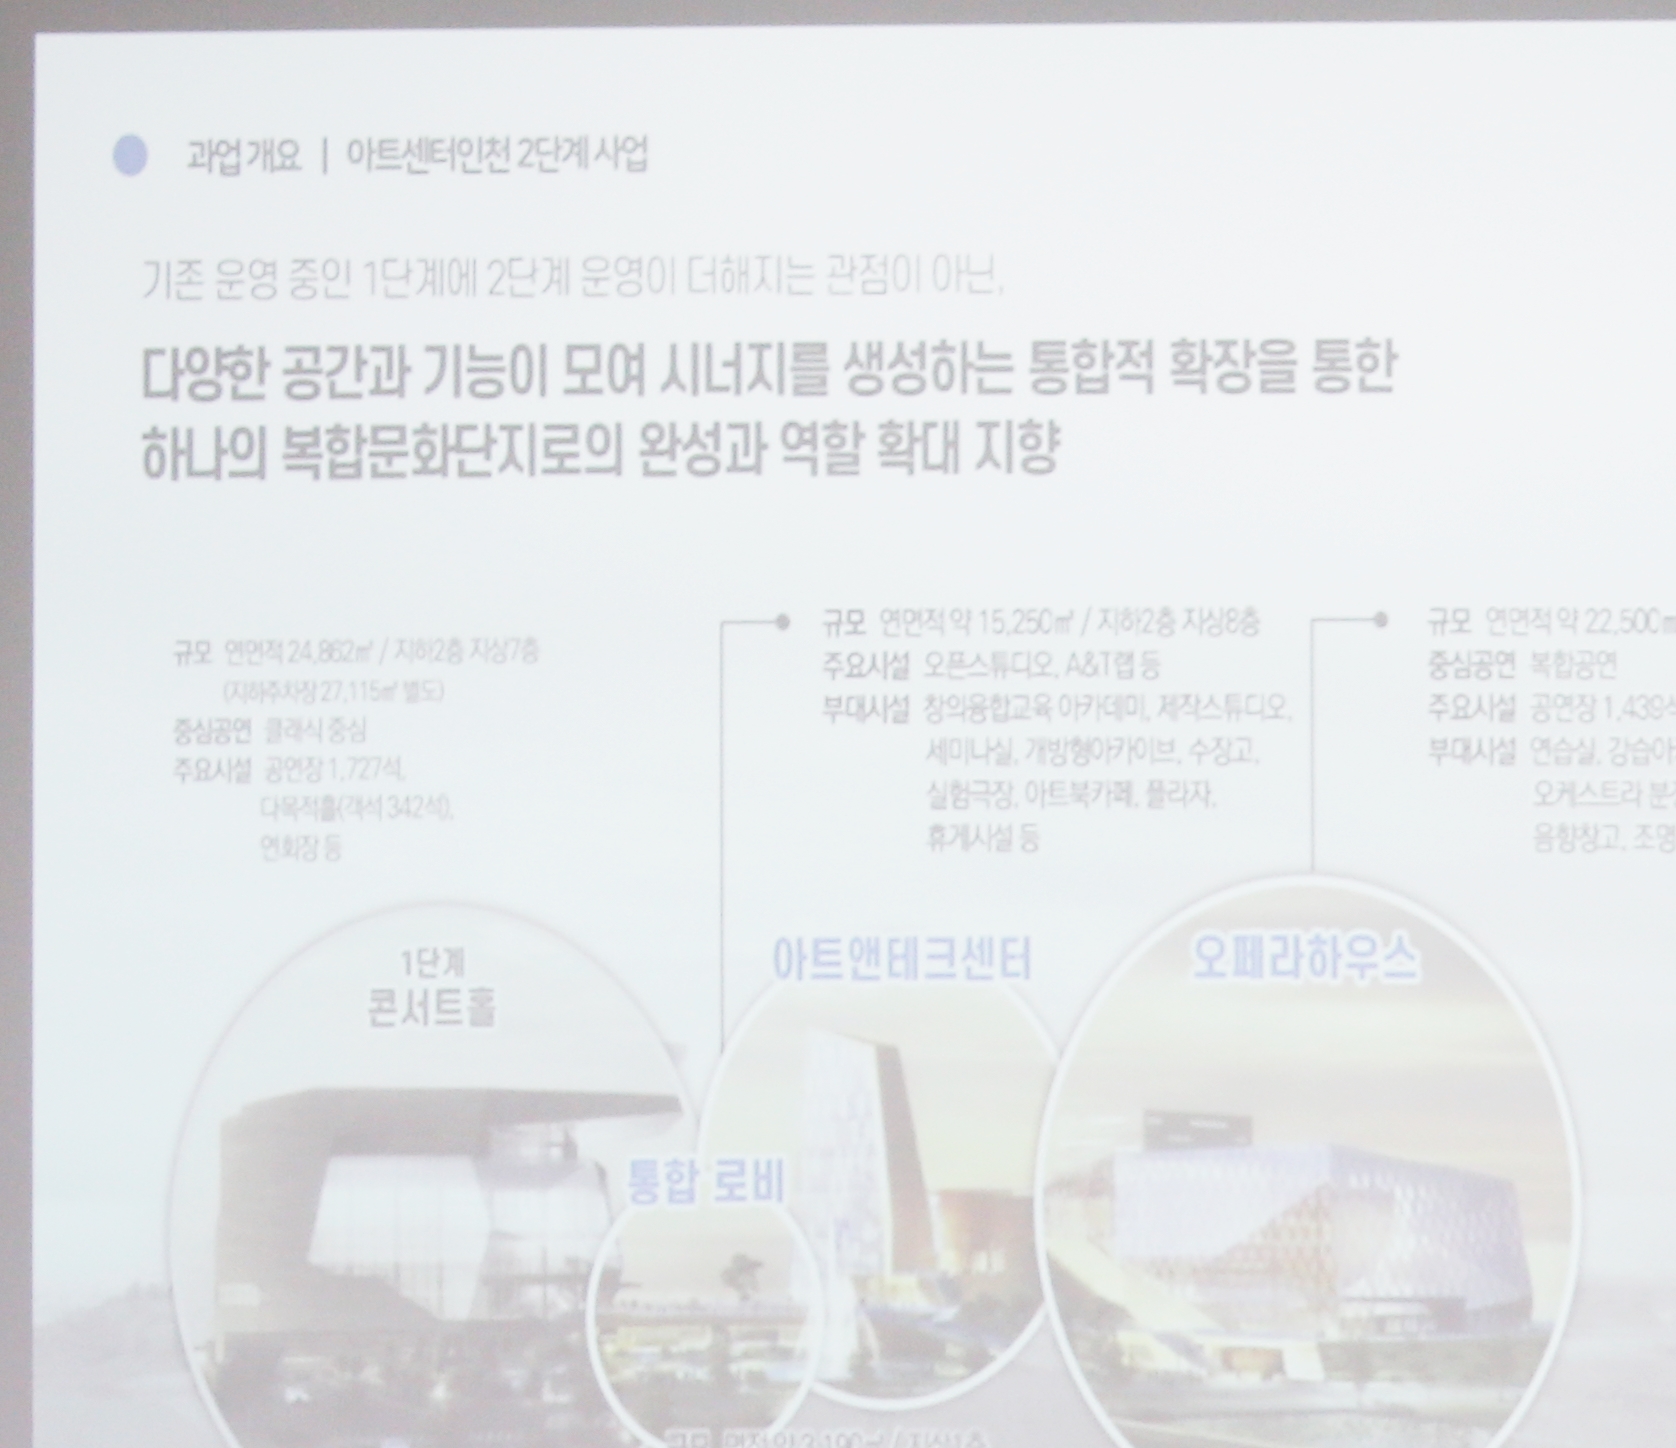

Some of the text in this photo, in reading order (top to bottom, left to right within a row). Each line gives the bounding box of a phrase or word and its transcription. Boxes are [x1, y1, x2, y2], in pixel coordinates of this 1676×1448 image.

[186, 137, 242, 178] 과업
[246, 137, 304, 175] 개요
[345, 135, 512, 177] 아트센터인천
[516, 134, 590, 175] 2단계
[592, 133, 649, 175] 사업
[142, 258, 205, 303] 기존
[215, 257, 279, 303] 운영
[288, 256, 352, 302] 중인
[362, 256, 478, 301] 1단계에
[485, 255, 571, 300] 2단계
[580, 254, 677, 299] 운영이
[686, 253, 816, 298] 더해지는
[826, 252, 922, 297] 관점이
[142, 335, 1400, 404] 다양한 공간과 기능이 모여 시너지를 생성하는 통합적 확장을 통한
[140, 417, 1062, 483] 하나의 복합문화단지로의 완성과 역할 확대 지향
[400, 947, 467, 980] 1단계
[771, 934, 1033, 983] 아트앤테크센터
[1192, 931, 1421, 983] 오페라하우스
[367, 987, 497, 1030] 콘서트홀
[626, 1157, 786, 1207] 통합 로비
